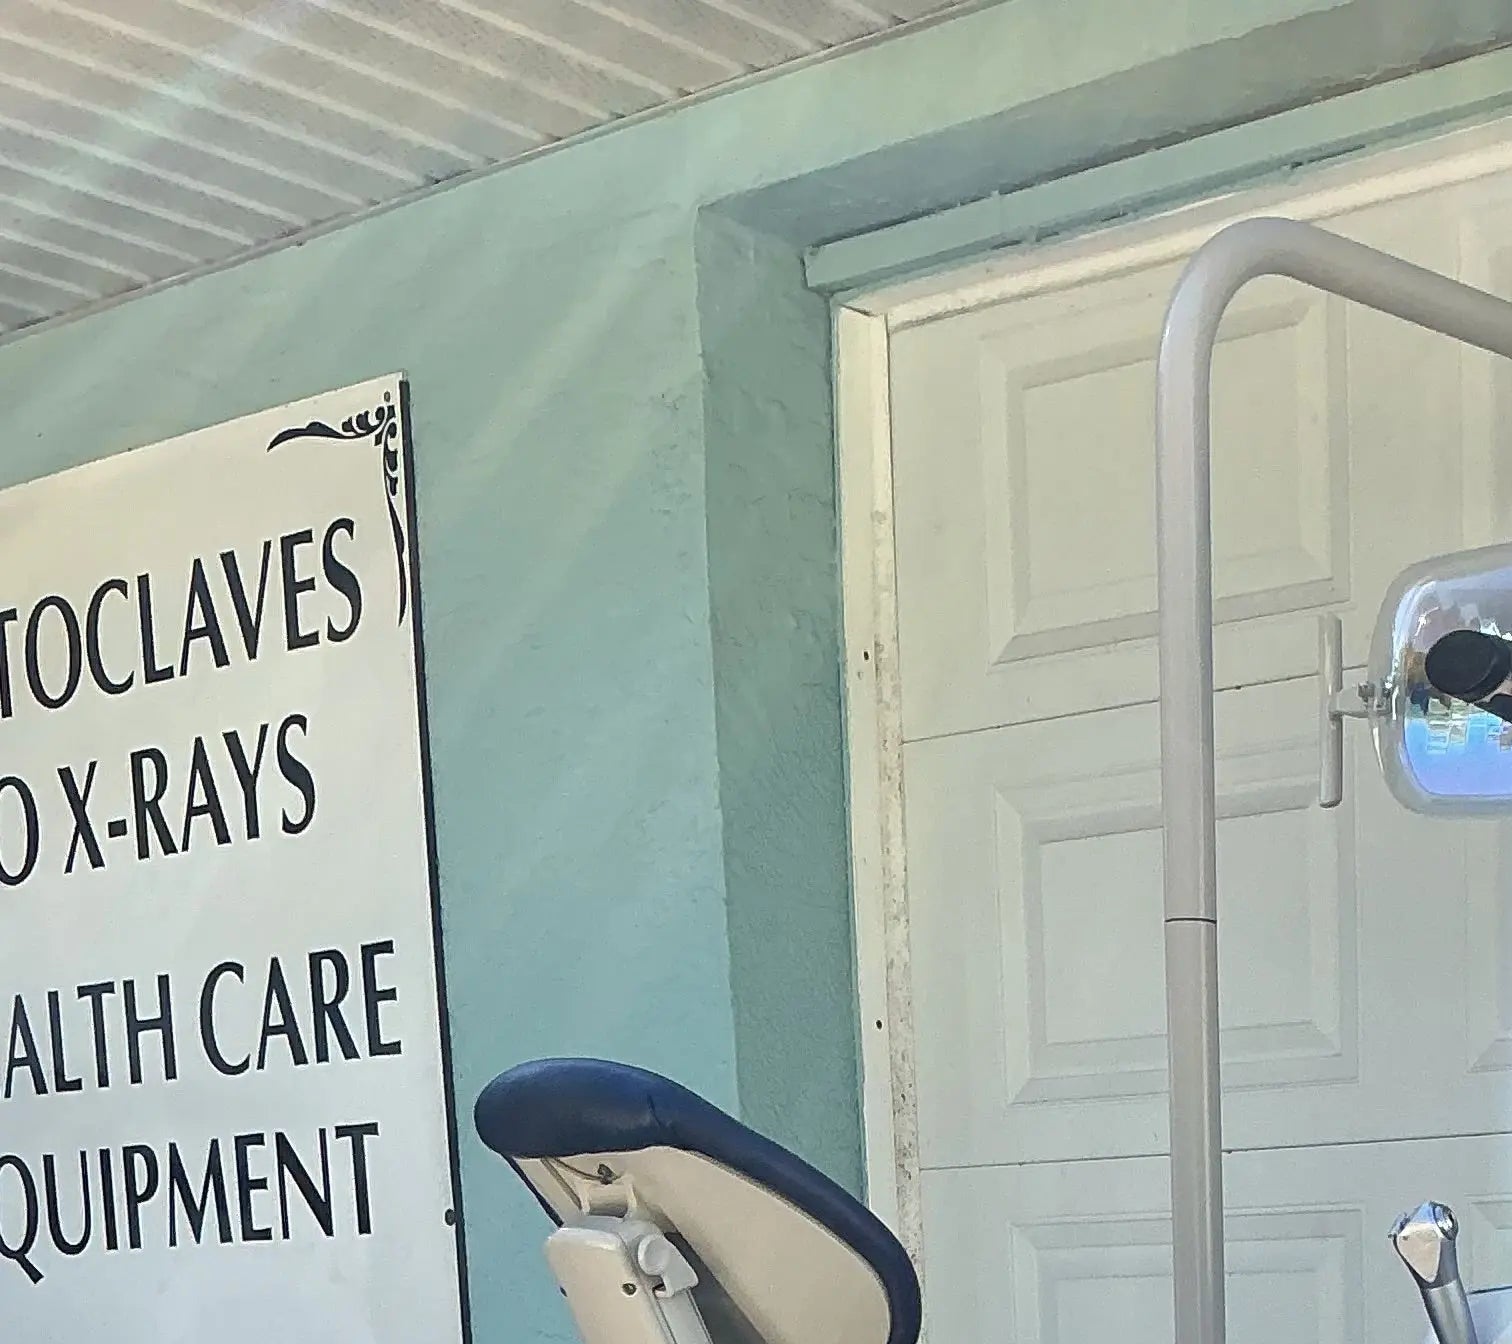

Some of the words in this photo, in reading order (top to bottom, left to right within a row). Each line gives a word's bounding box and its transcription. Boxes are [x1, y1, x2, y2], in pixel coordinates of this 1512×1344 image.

[57, 713, 316, 874] X-RAYS
[4, 973, 178, 1099] ALTH
[199, 939, 402, 1076] CARE
[0, 1122, 379, 1285] QUIPMENT
